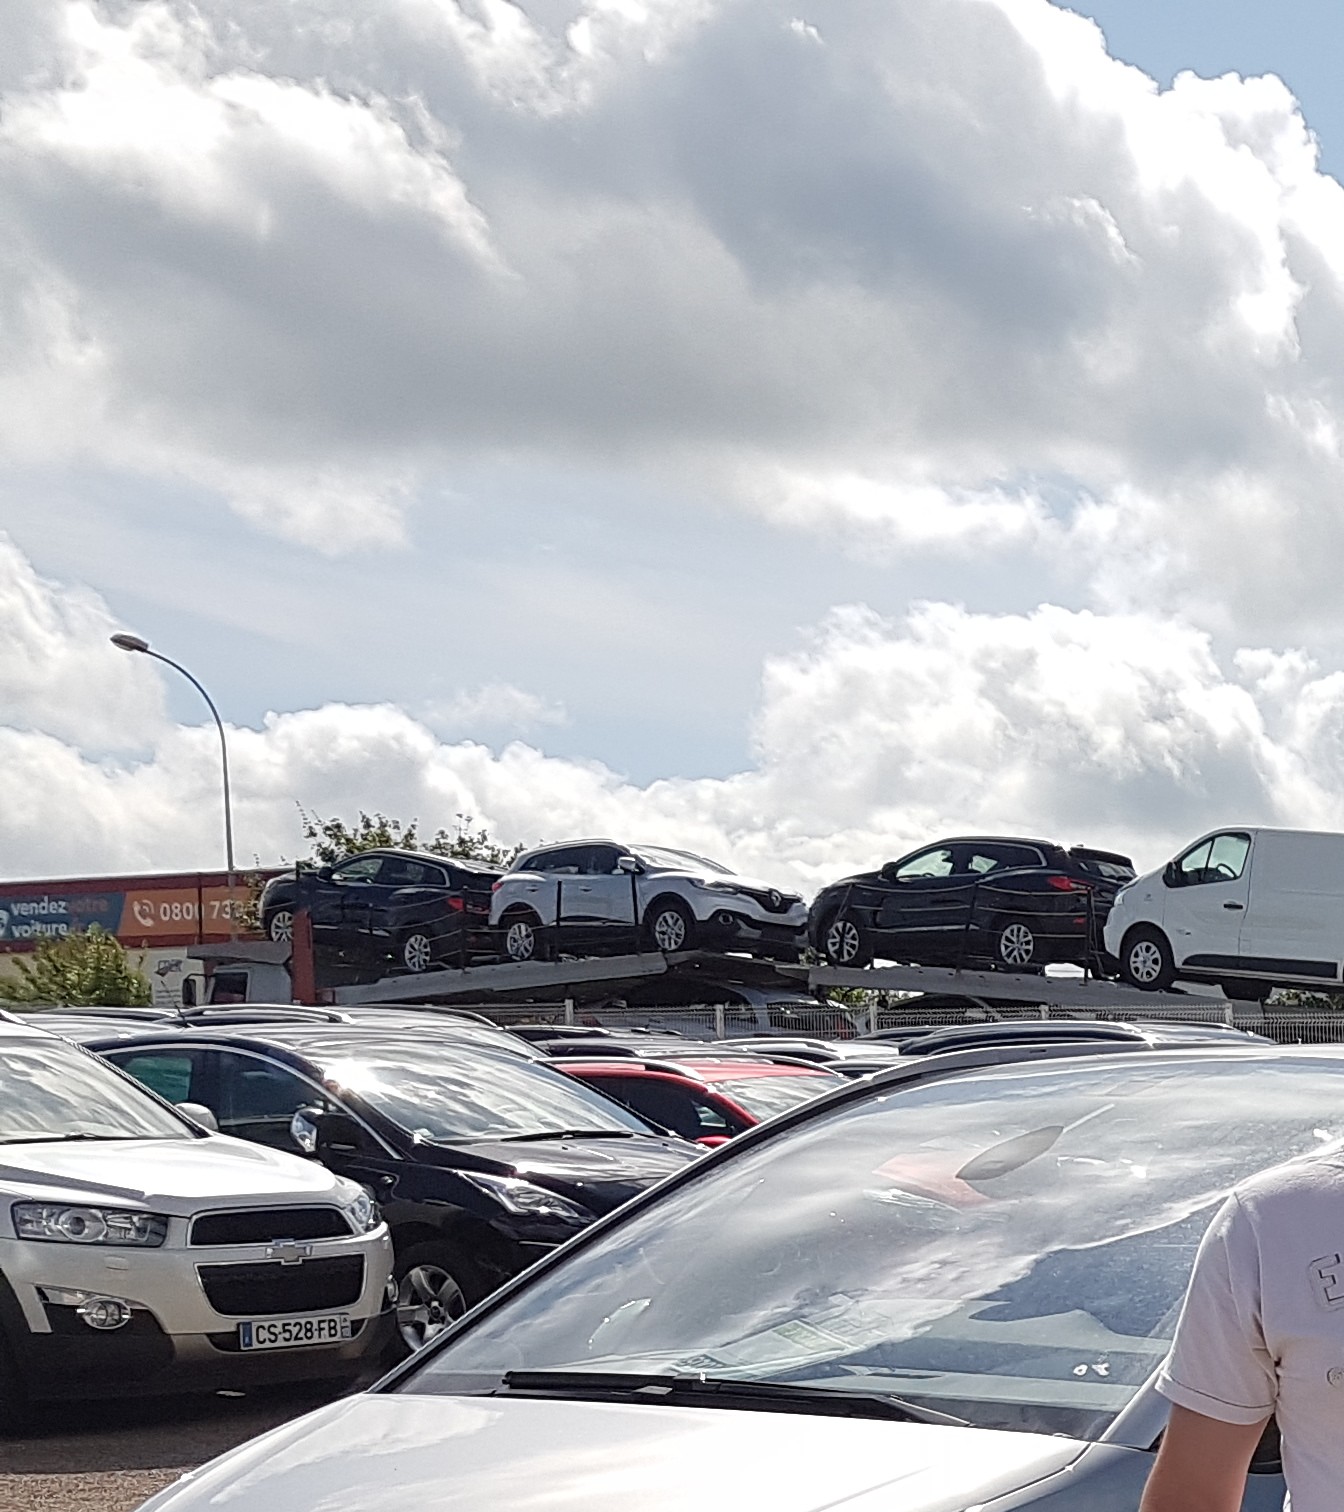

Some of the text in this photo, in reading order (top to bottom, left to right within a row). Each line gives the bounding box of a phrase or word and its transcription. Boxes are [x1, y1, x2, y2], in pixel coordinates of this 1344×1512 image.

[11, 896, 67, 916] vendez
[11, 920, 68, 938] voiture
[255, 1319, 338, 1345] CS-528-FB
